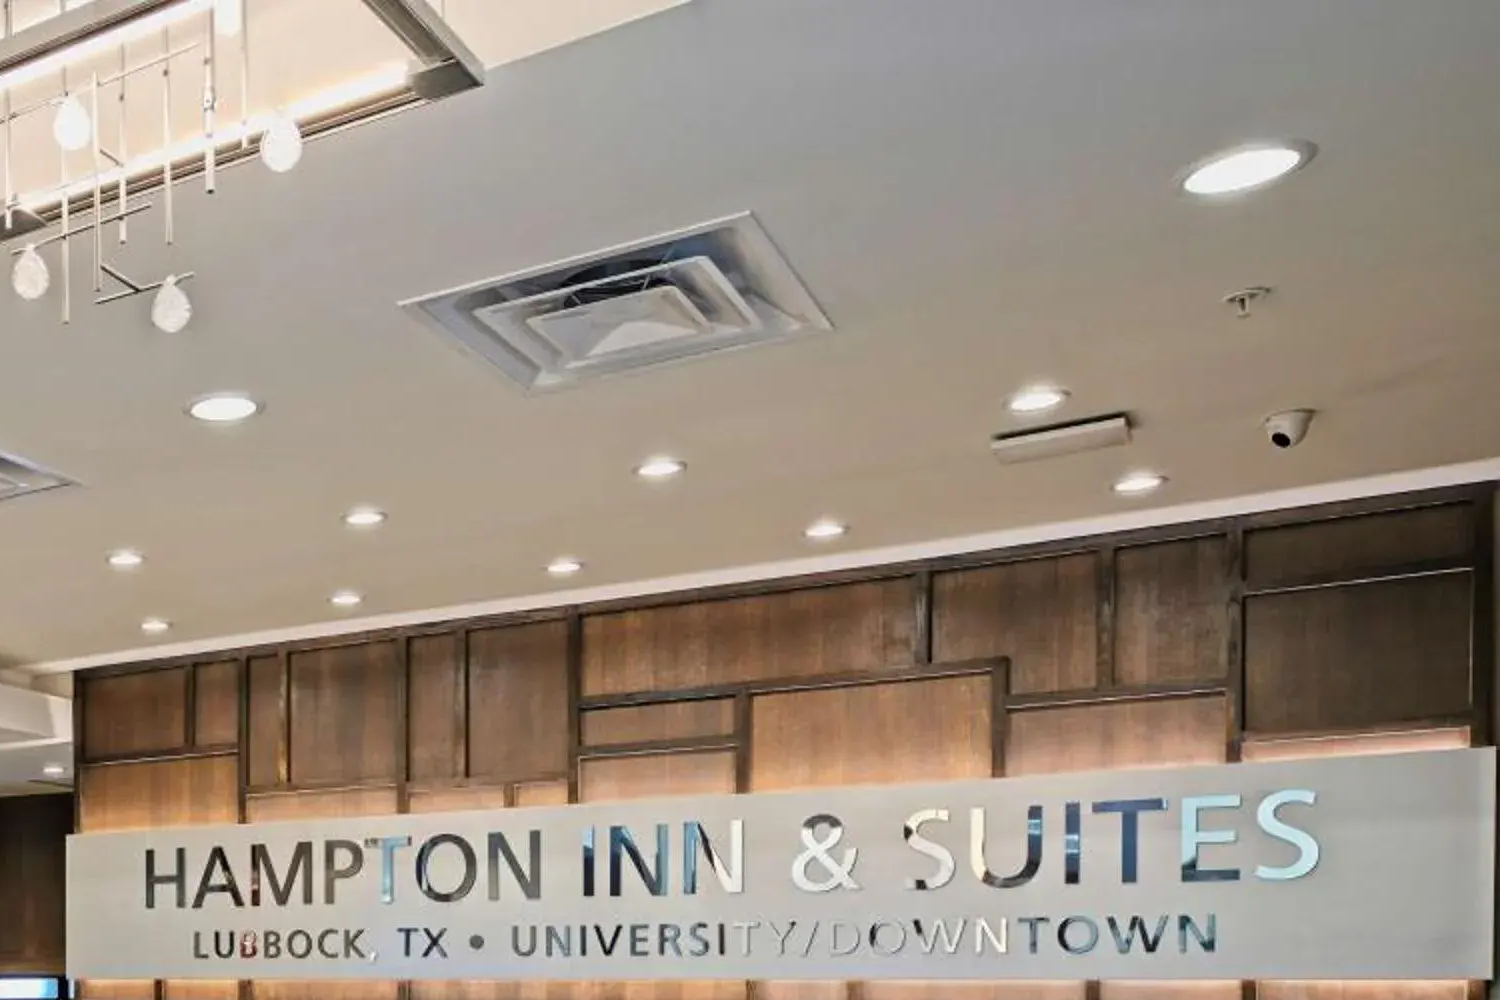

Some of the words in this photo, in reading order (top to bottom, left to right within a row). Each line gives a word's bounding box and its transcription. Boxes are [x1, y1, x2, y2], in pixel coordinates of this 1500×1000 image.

[145, 829, 541, 909] HAMPTON
[582, 818, 744, 897] INN
[791, 813, 863, 892] &
[903, 789, 1320, 890] SUITES
[193, 928, 378, 963] LUBBOCK,
[397, 927, 448, 957] TX
[511, 913, 1216, 957] UNIVERSITY/DOWNTOWN
